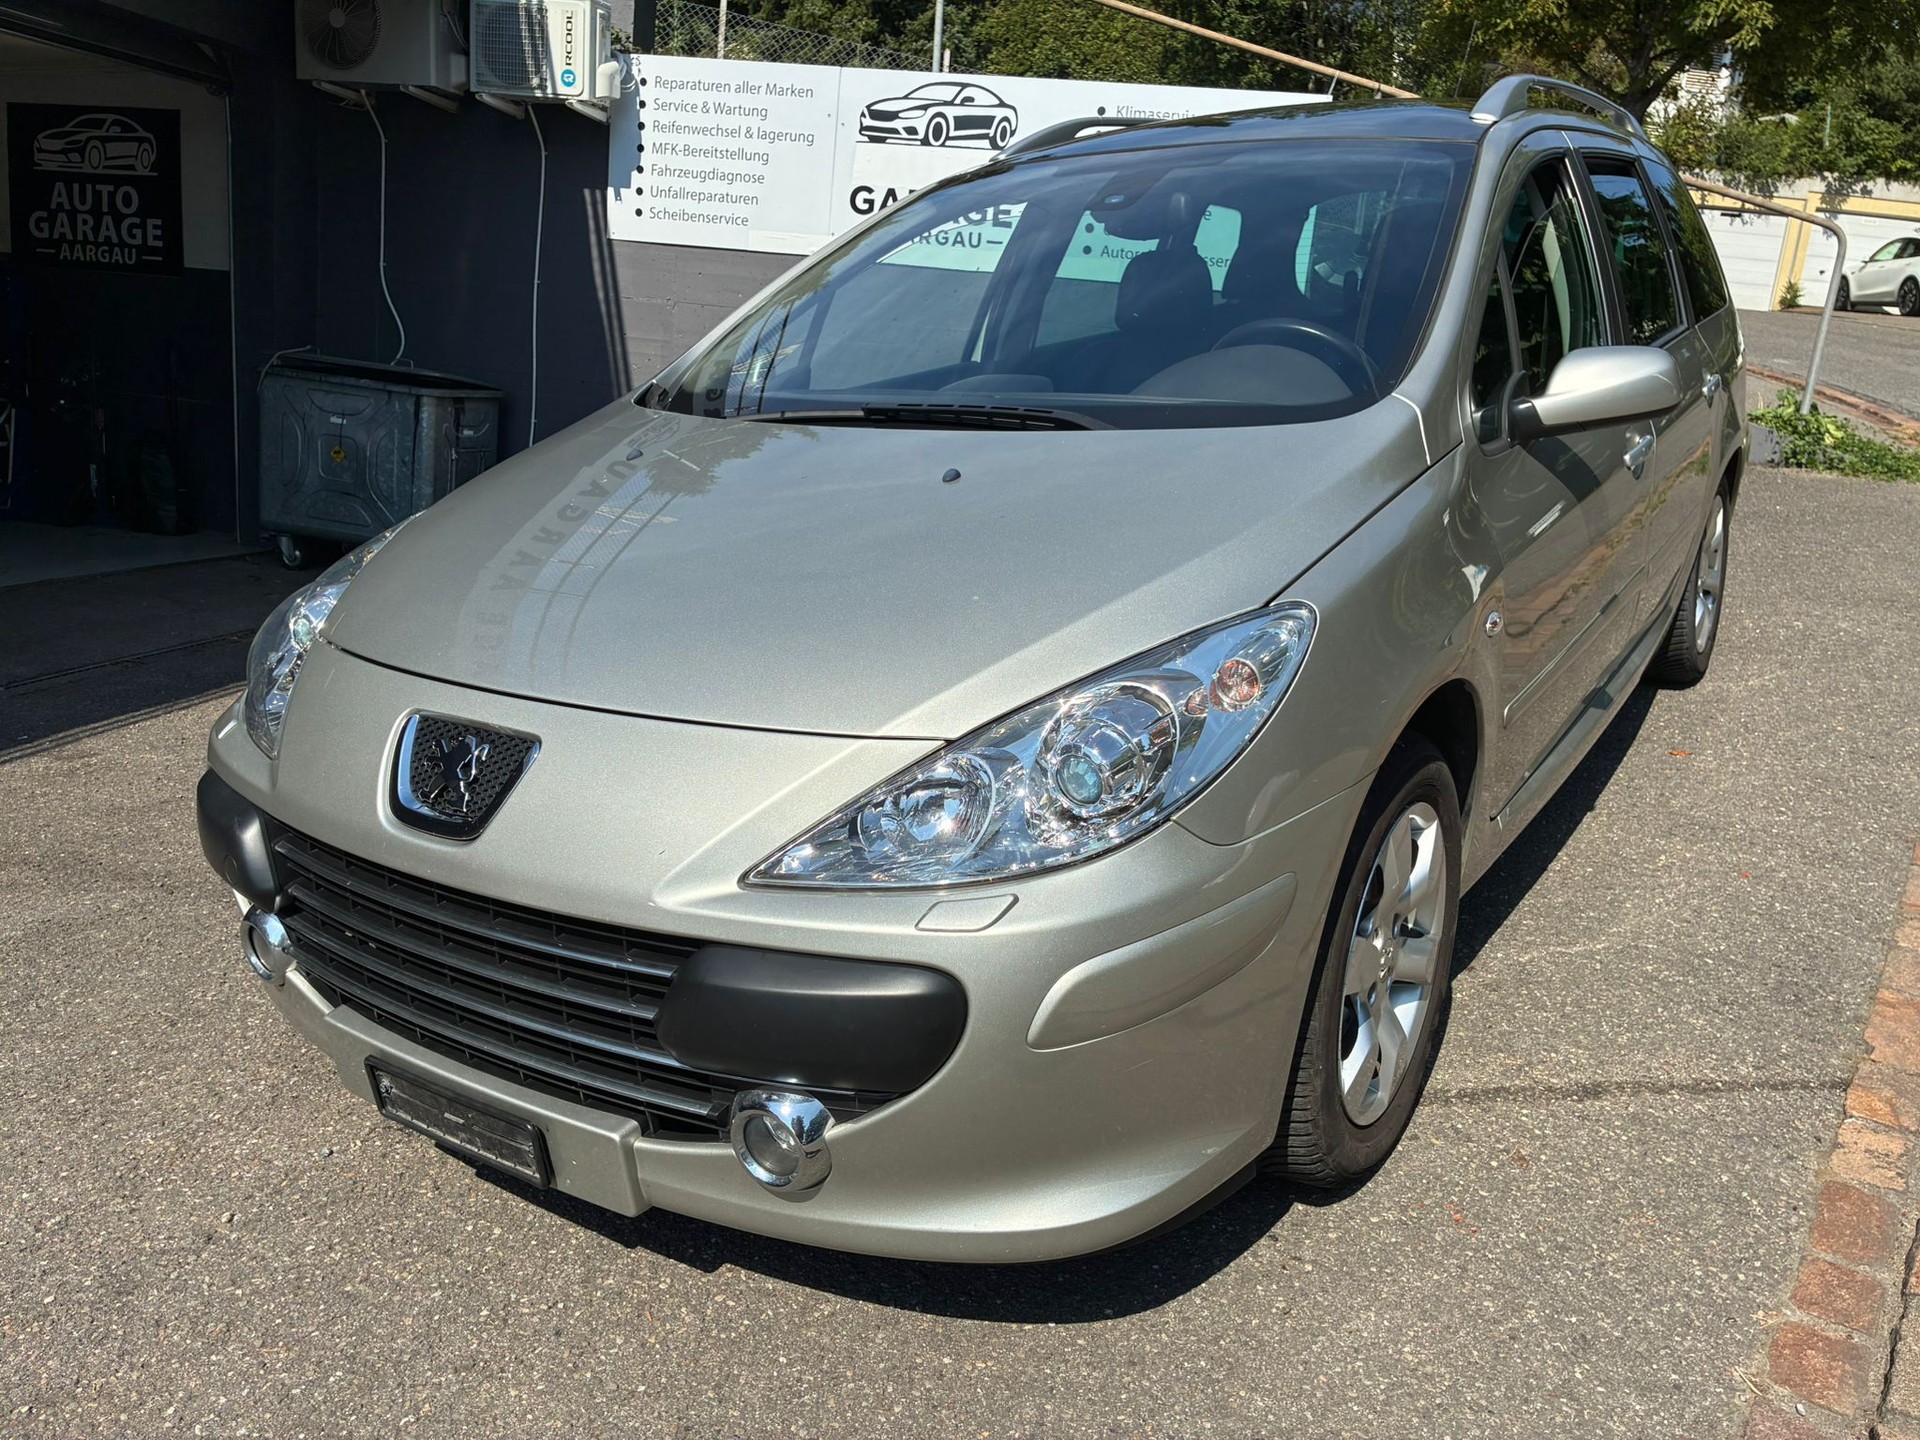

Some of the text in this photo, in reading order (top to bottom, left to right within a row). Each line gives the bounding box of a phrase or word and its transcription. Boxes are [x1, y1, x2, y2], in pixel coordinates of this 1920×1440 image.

[654, 76, 814, 98] Reparaturen aller Marken
[653, 98, 768, 121] Service & Wartung
[652, 120, 815, 146] Reifenwechsel & lagerung
[651, 142, 769, 165] MFK-Bereitstellung
[650, 164, 765, 185] Fahrzeugdiagnose
[50, 182, 139, 214] AUTO
[650, 186, 759, 205] Unfallreparaturen
[649, 207, 749, 226] Scheibenservice
[28, 211, 163, 247] GARAGE
[59, 243, 136, 265] AARGAU
